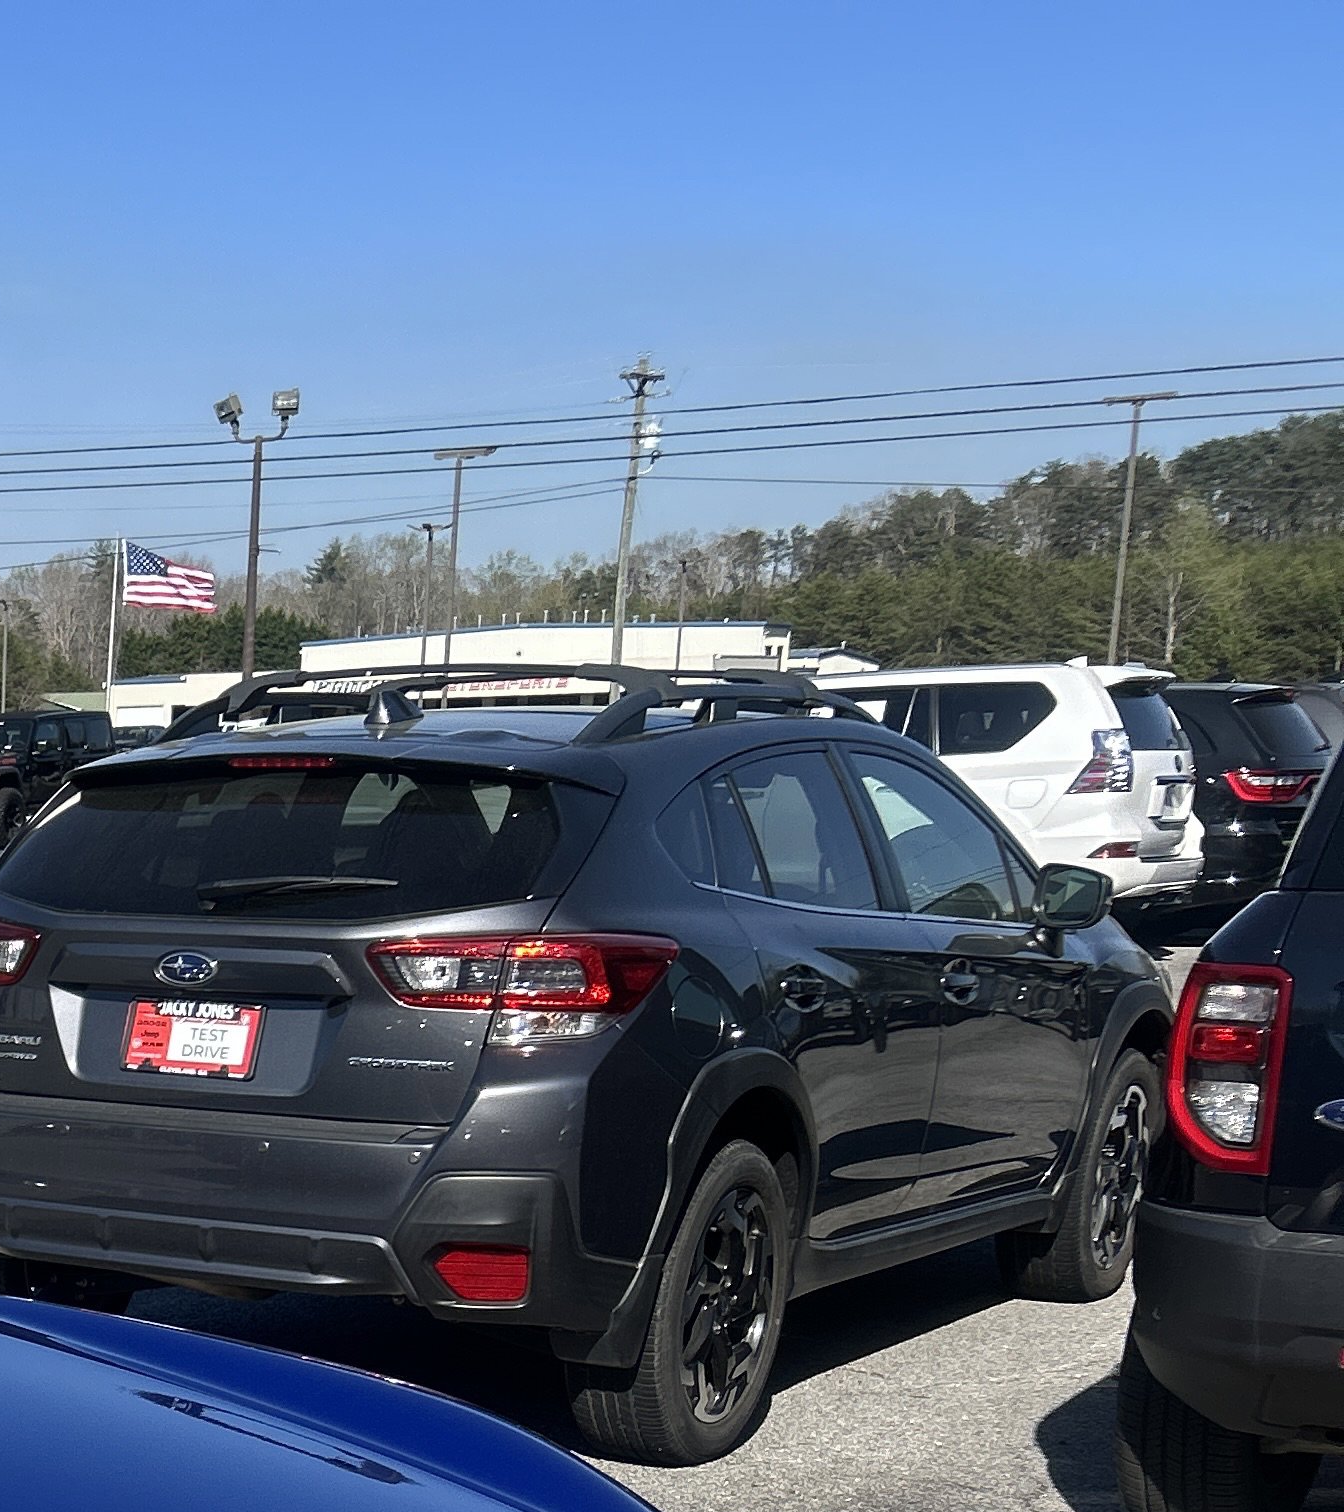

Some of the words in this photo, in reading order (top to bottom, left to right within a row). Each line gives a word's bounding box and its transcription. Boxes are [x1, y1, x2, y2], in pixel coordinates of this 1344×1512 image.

[159, 1001, 196, 1017] JACKY
[196, 1003, 235, 1019] JONES
[190, 1027, 229, 1042] TEST
[181, 1043, 231, 1059] DRIVE
[348, 1056, 455, 1072] CROSSTREK
